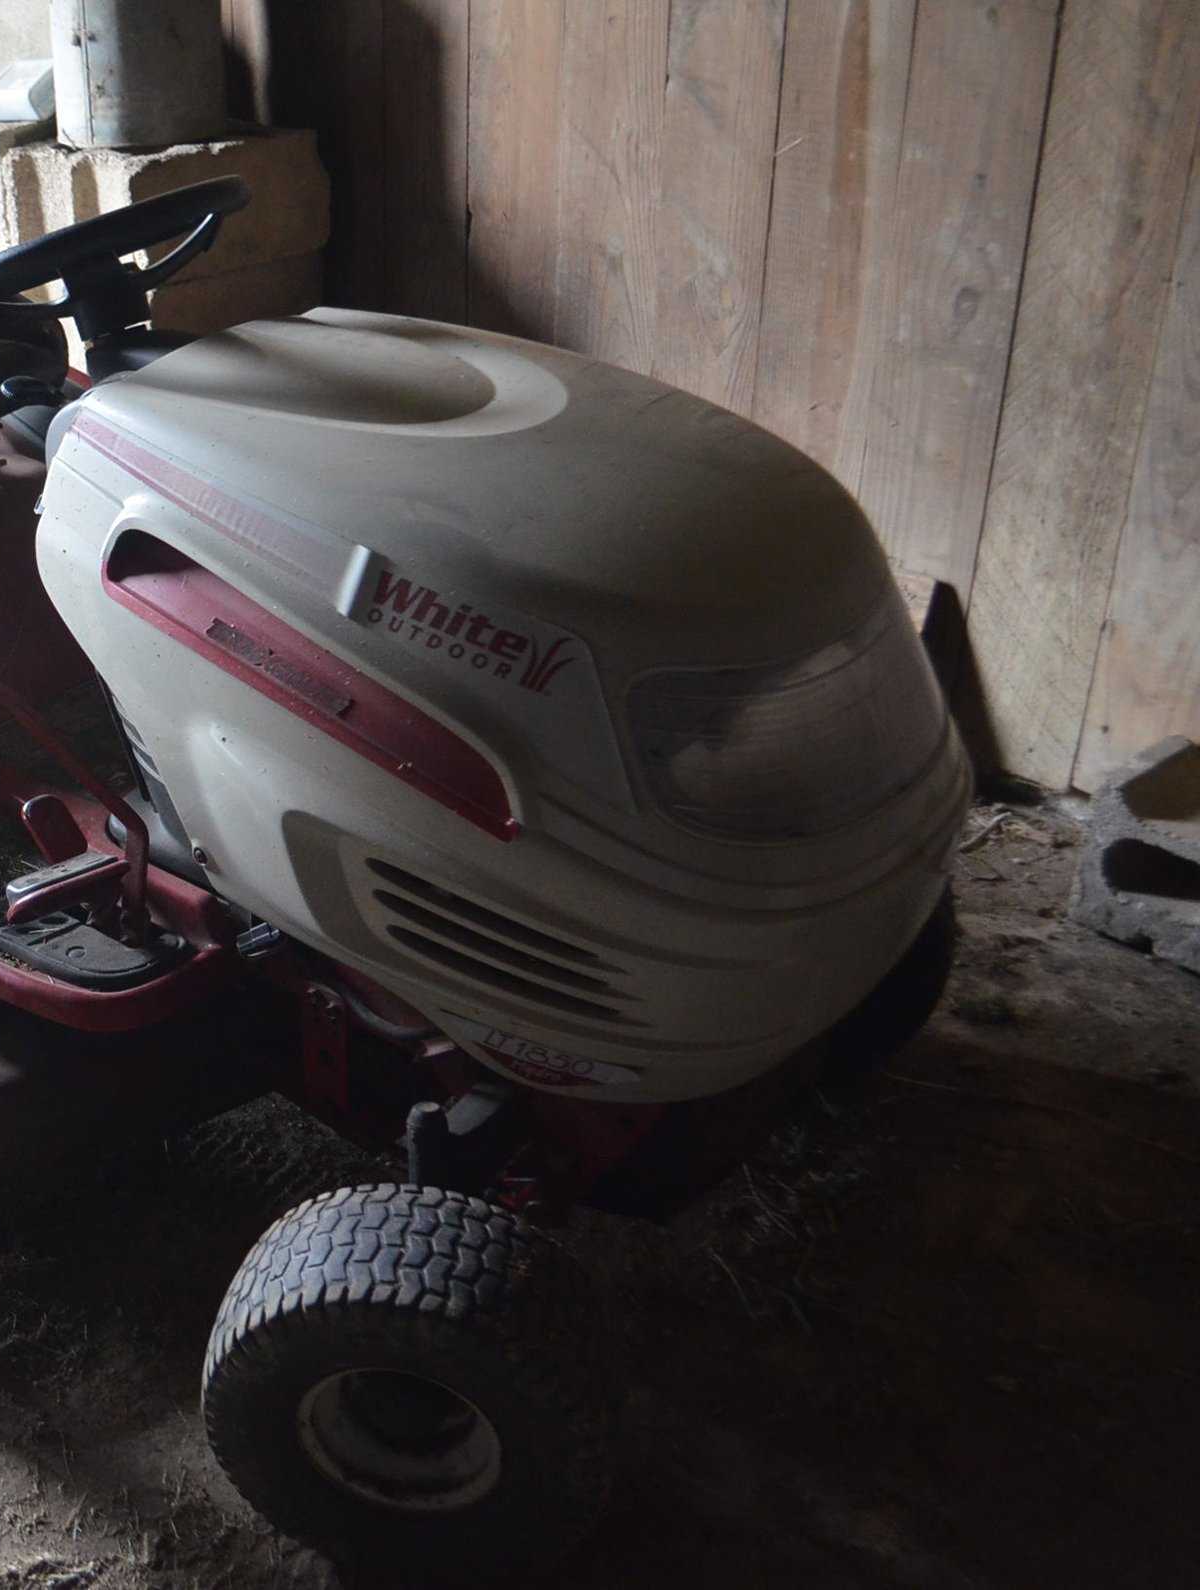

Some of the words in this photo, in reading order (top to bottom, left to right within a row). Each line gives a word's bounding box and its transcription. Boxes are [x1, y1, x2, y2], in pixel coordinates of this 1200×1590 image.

[367, 608, 513, 680] OUTDOOR
[371, 570, 529, 661] White
[484, 1030, 595, 1075] LT1850
